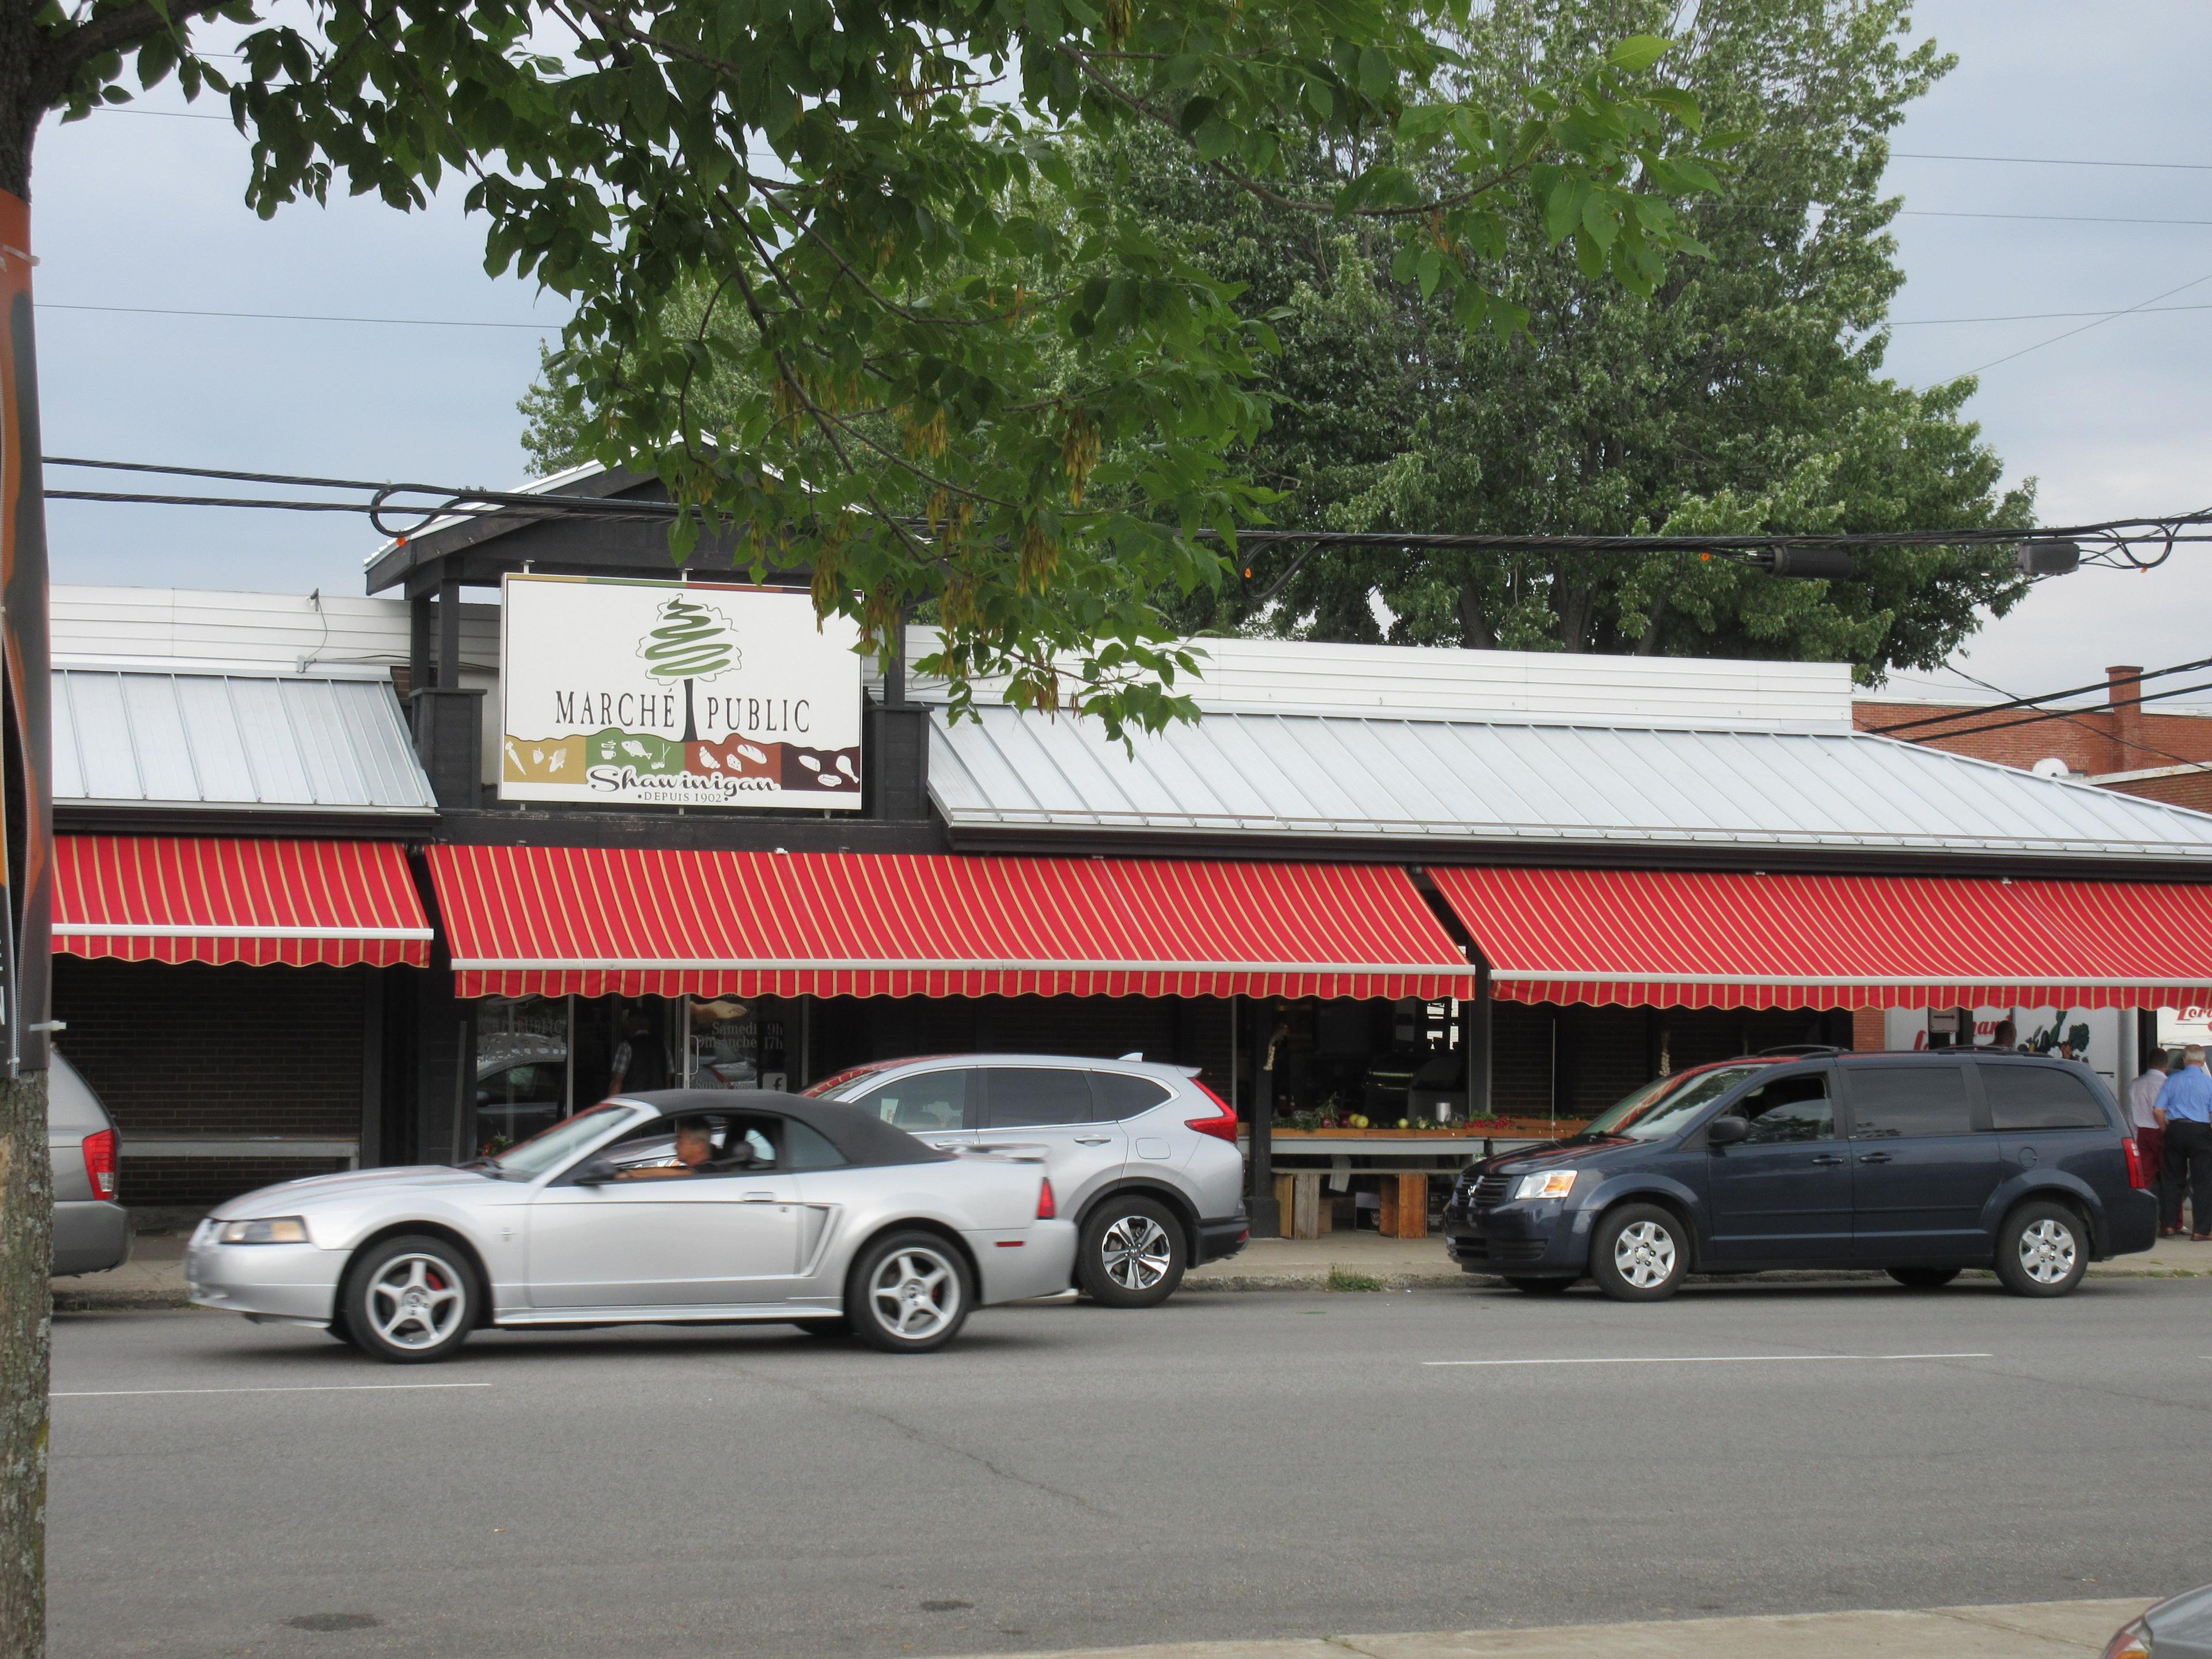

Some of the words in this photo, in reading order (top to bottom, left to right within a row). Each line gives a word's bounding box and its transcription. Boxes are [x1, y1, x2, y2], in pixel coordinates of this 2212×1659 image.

[555, 688, 675, 728] MARCHÉ
[707, 696, 810, 733] PUBLIC
[590, 767, 777, 797] Shawinigan
[644, 791, 690, 802] DEPUIS
[694, 793, 722, 803] 1902
[712, 1021, 757, 1035] Samedi
[767, 1022, 783, 1036] 9h
[764, 1036, 783, 1050] 17h
